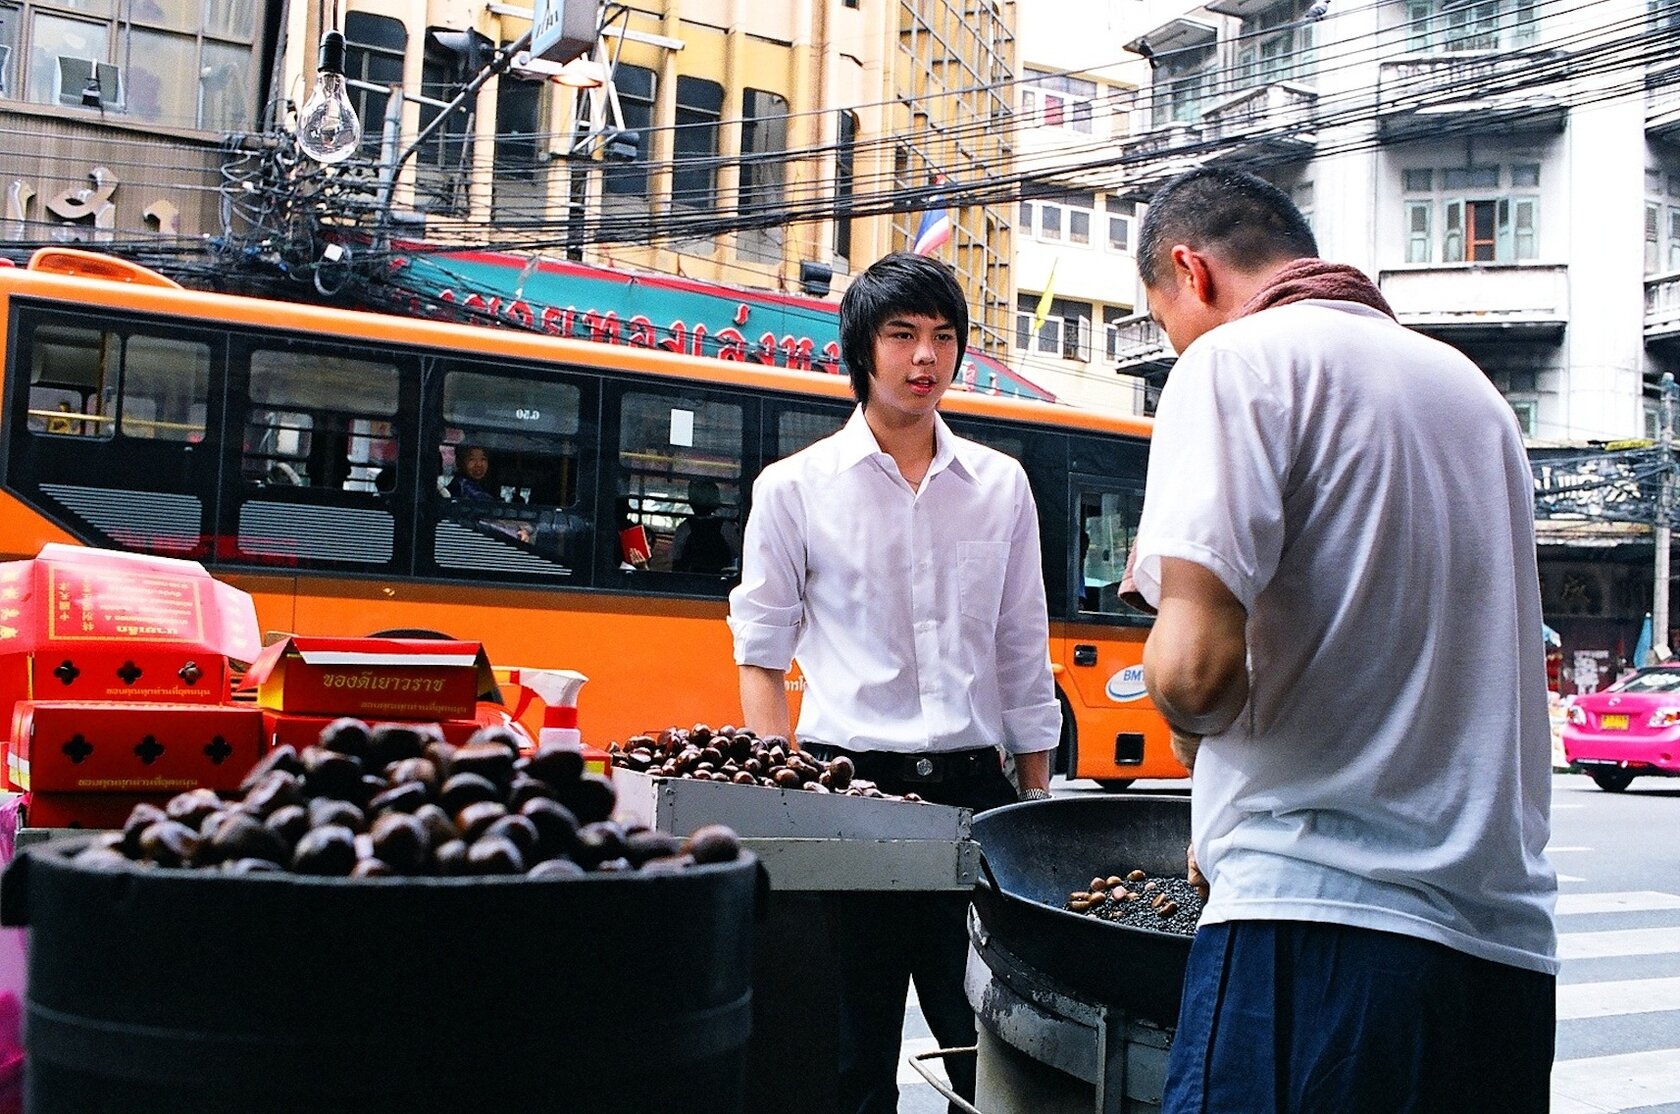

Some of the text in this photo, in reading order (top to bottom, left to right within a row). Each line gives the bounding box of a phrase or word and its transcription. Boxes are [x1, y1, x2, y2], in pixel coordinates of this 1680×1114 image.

[323, 671, 446, 692] ของดีเยาวราช
